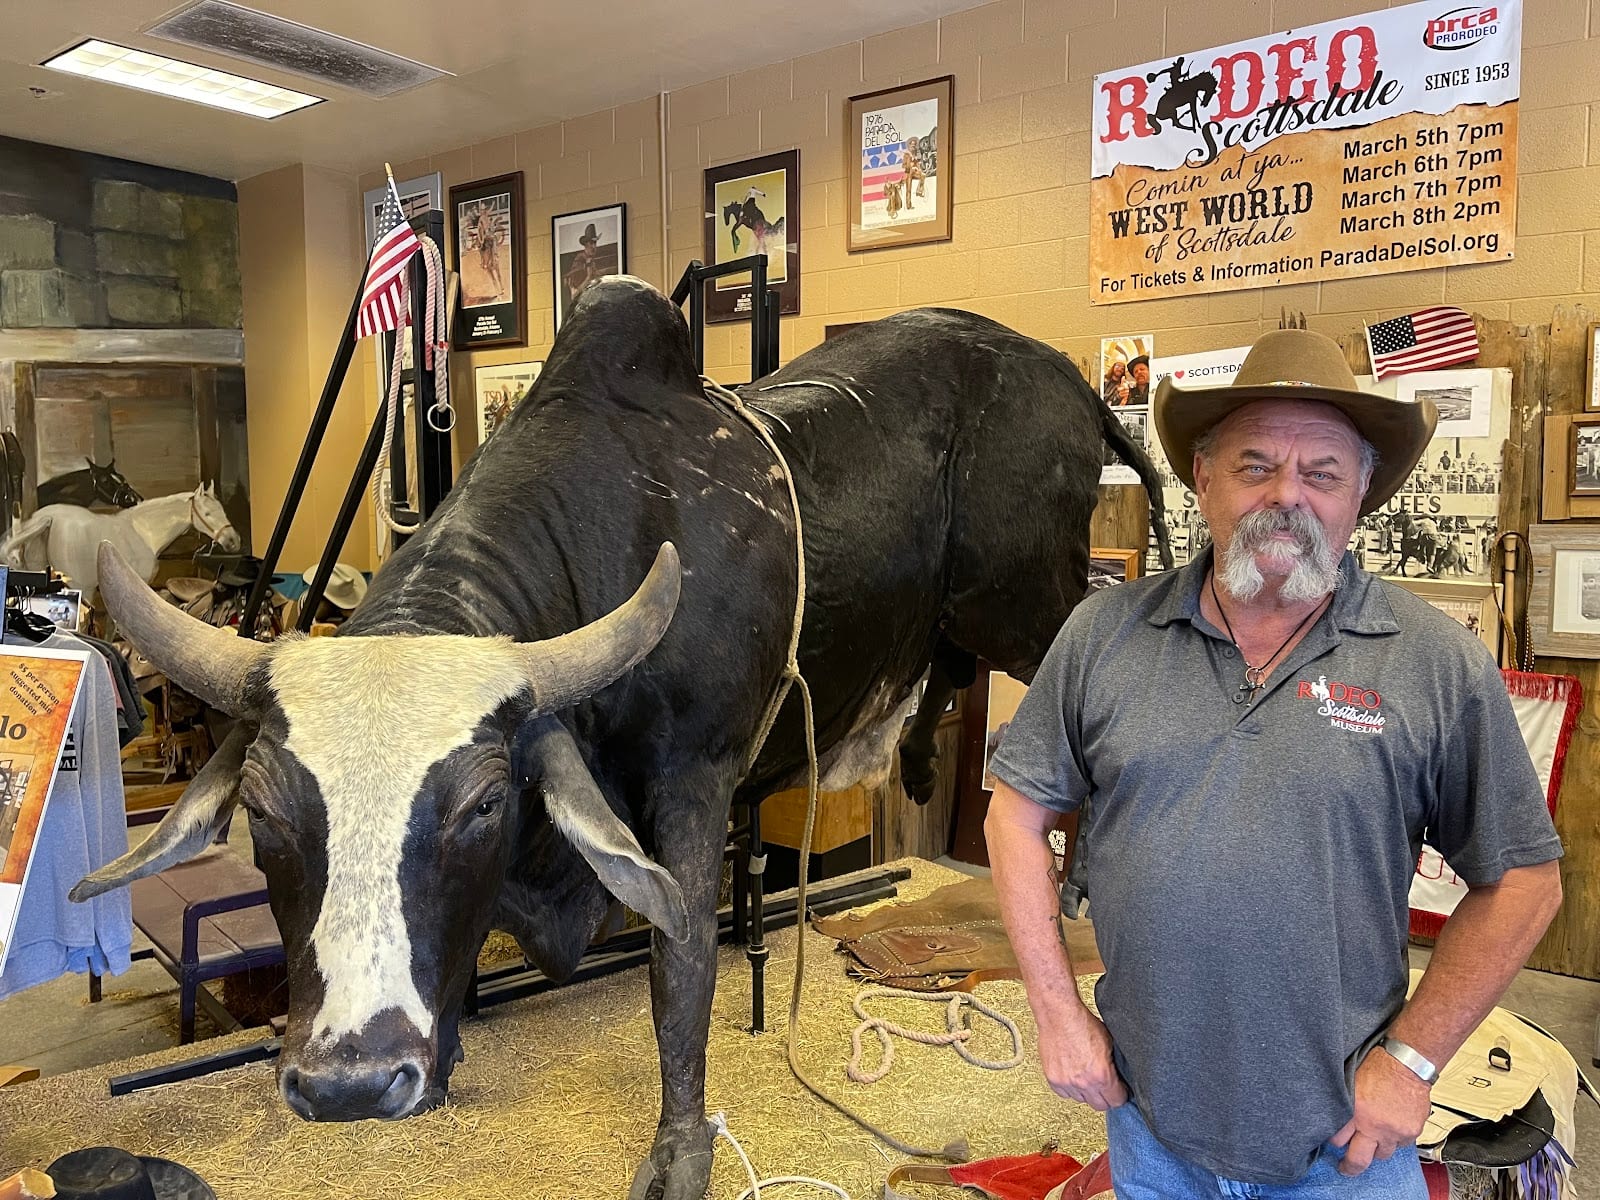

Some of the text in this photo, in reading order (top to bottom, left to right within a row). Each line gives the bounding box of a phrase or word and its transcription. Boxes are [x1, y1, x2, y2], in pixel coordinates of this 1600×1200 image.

[1426, 7, 1498, 46] prca
[1436, 25, 1498, 45] PRORODEO
[1100, 26, 1379, 144] RDEO
[1425, 62, 1510, 91] SINCE 1953
[865, 122, 896, 136] PARADA
[866, 114, 883, 126] 1976
[1184, 70, 1404, 168] Scottsdale
[865, 132, 903, 147] DEL SOL
[1343, 122, 1503, 160] March 5th 7pm
[1221, 153, 1260, 181] at
[1342, 148, 1502, 184] March 6th 7pm
[1341, 174, 1501, 209] March 7th 7pm
[1108, 181, 1313, 239] WEST WORLD
[1340, 201, 1500, 234] March 8th 2pm
[1145, 216, 1296, 263] of Scottsdale
[1101, 233, 1499, 293] For Tickets & Information ParadaDelSol.org
[1376, 495, 1441, 513] CEE'S
[10, 671, 53, 714] suggested min
[10, 686, 37, 716] donation
[26, 671, 39, 683] per
[37, 683, 60, 706] person
[1297, 680, 1381, 710] RDEO
[1318, 698, 1386, 726] Scottsdale
[1331, 718, 1383, 734] MUSEUM
